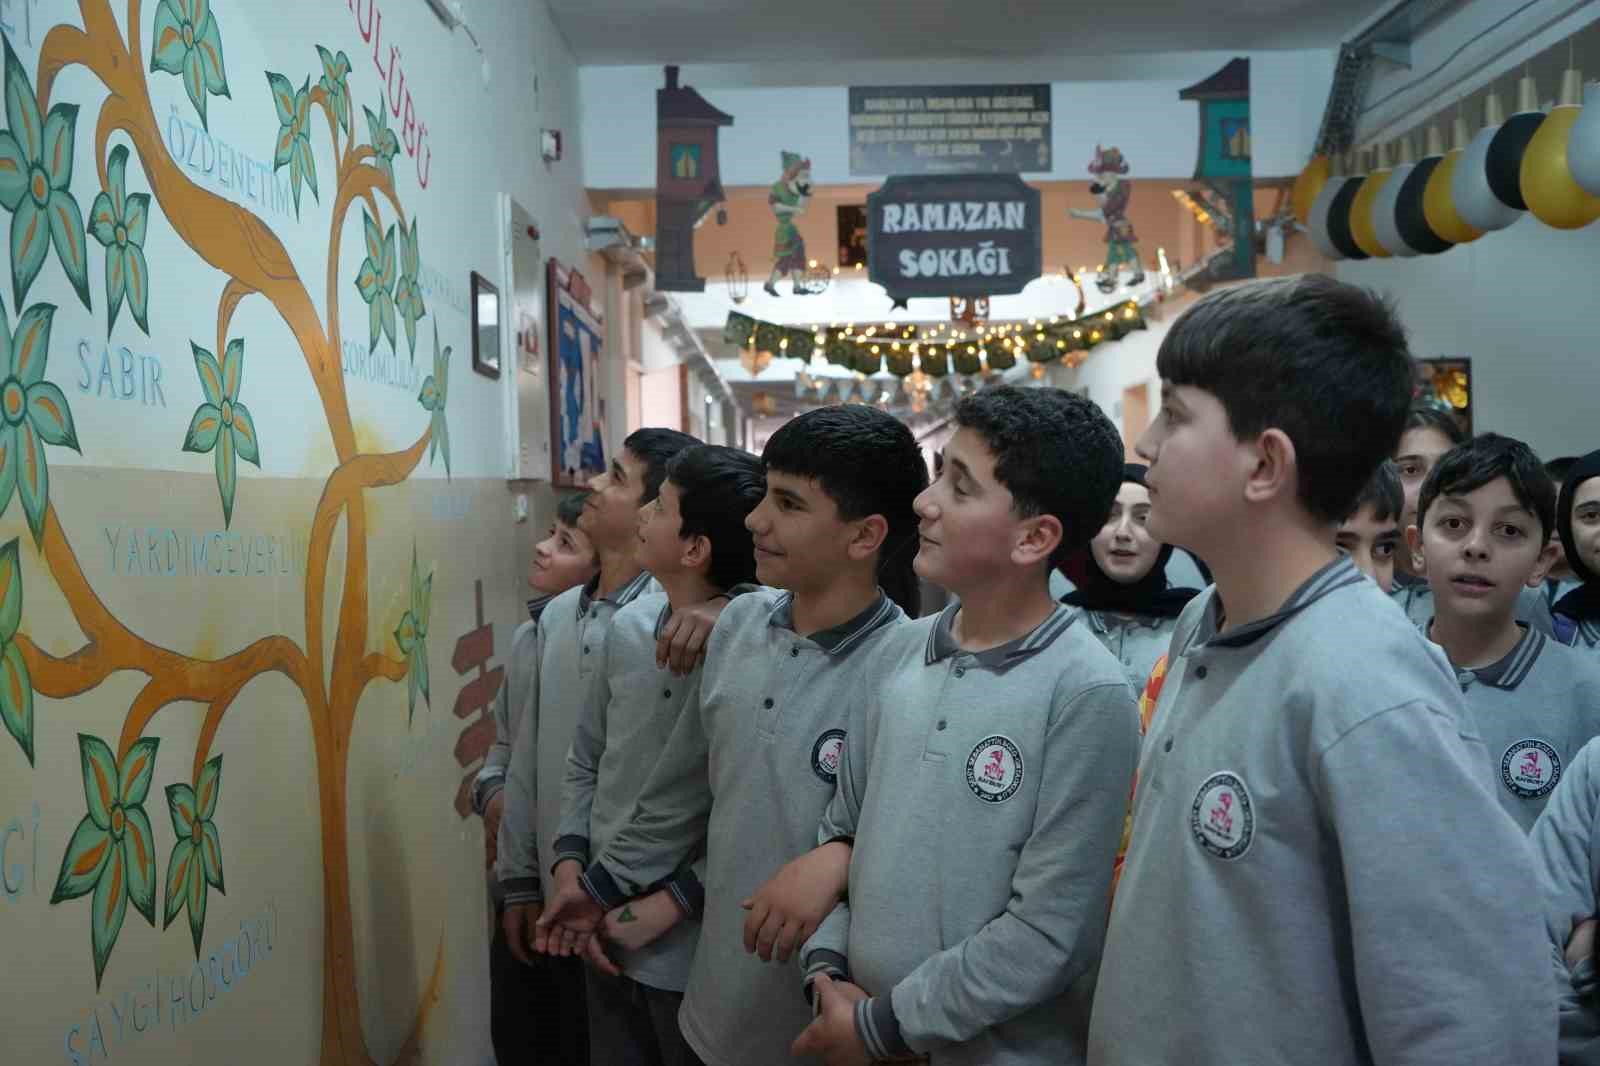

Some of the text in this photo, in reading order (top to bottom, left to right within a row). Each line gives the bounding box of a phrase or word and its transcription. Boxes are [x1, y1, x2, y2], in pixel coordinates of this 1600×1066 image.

[347, 0, 431, 190] ULÜBÜ
[882, 201, 1026, 233] RAMAZAN
[898, 240, 1013, 278] SOKAĞI
[78, 339, 167, 408] SABIR
